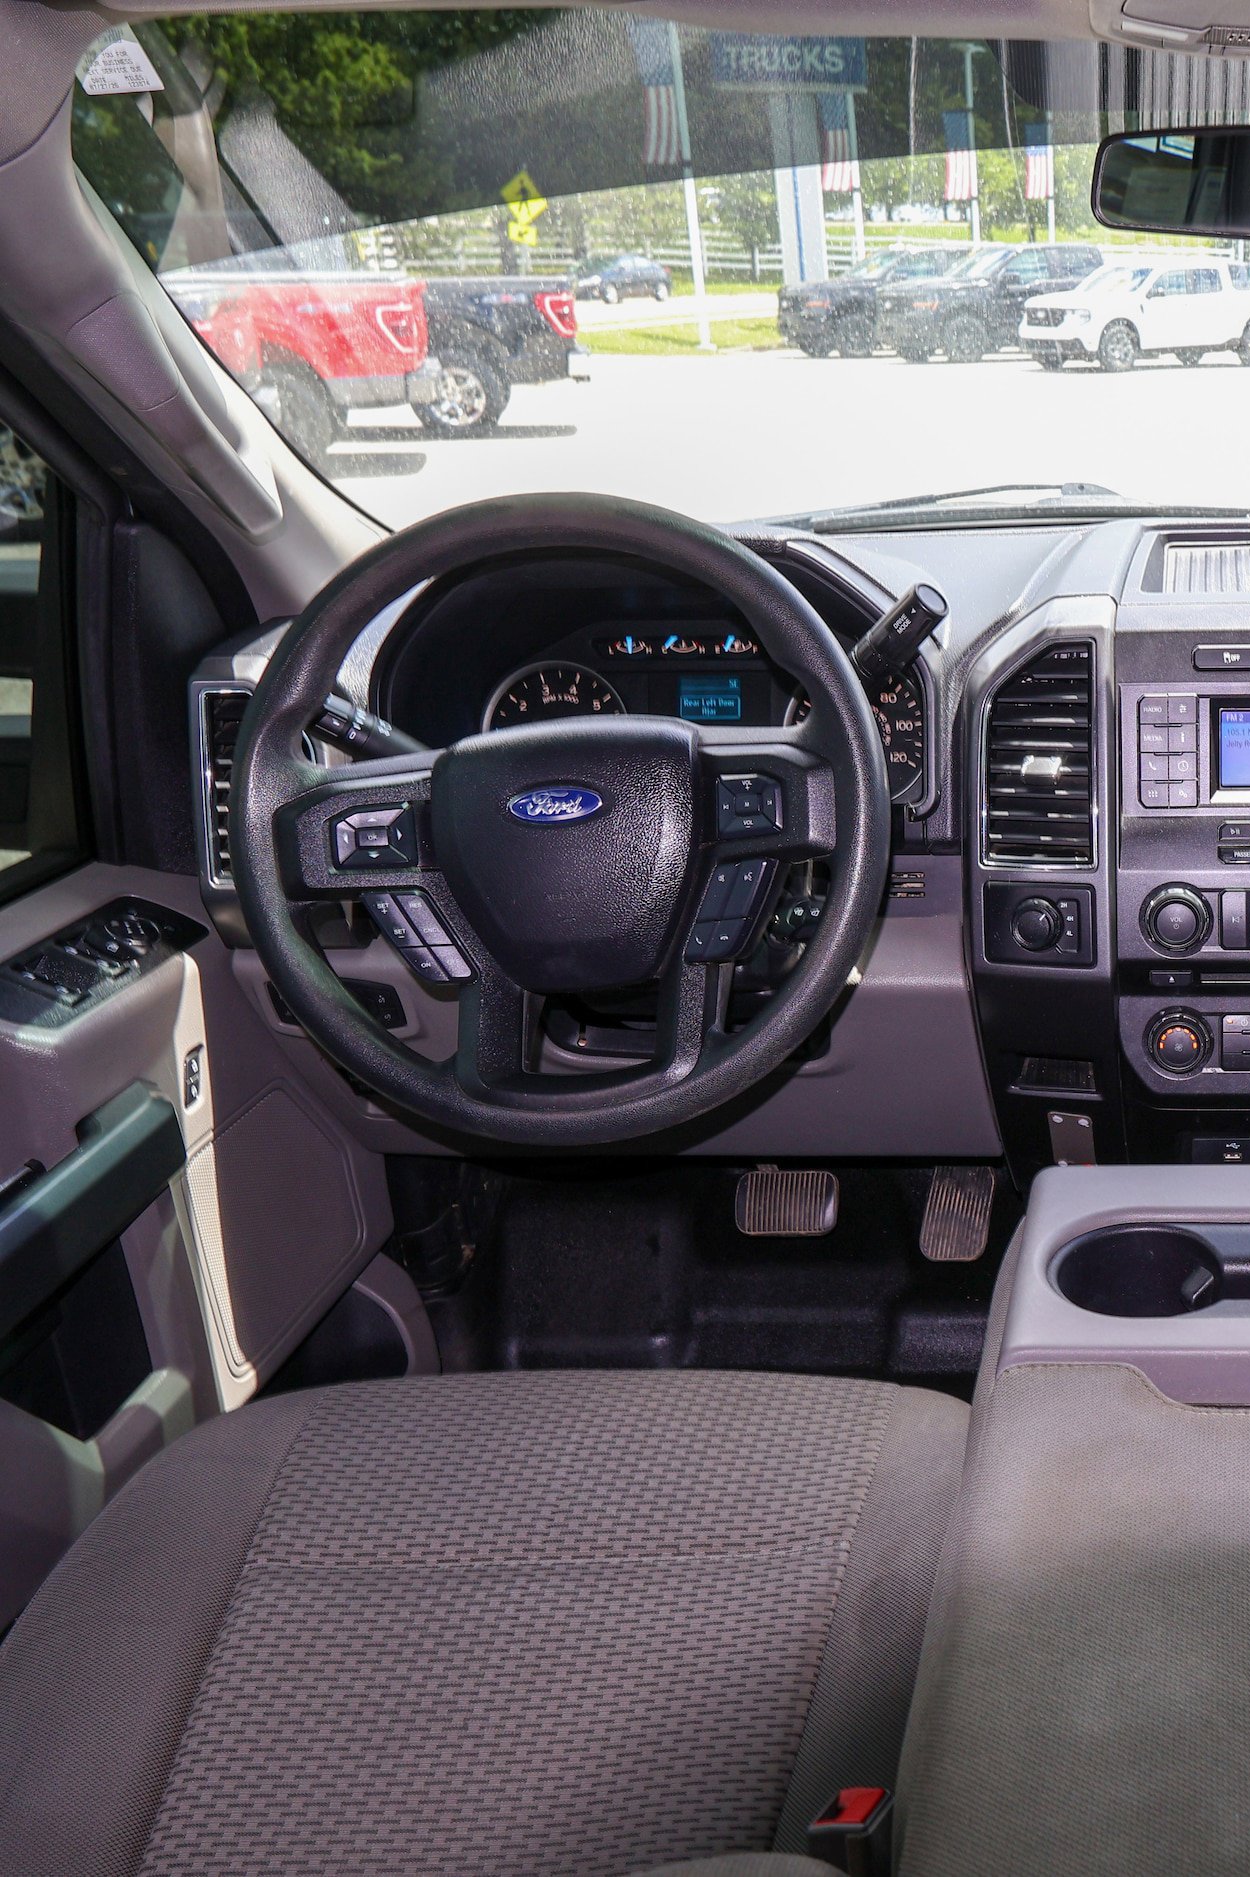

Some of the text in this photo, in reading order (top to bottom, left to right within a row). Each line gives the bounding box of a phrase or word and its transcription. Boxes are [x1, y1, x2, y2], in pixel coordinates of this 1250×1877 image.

[725, 44, 844, 73] TRUCKS
[893, 614, 908, 630] DRIVE
[897, 618, 912, 634] MODE
[542, 684, 550, 696] 3
[569, 684, 577, 696] 4
[684, 697, 734, 706] Rear Left Door
[880, 692, 897, 703] 80
[520, 700, 527, 712] 2
[593, 699, 601, 711] 5
[896, 720, 913, 731] 100
[890, 752, 907, 763] 120
[526, 791, 582, 816] Ford
